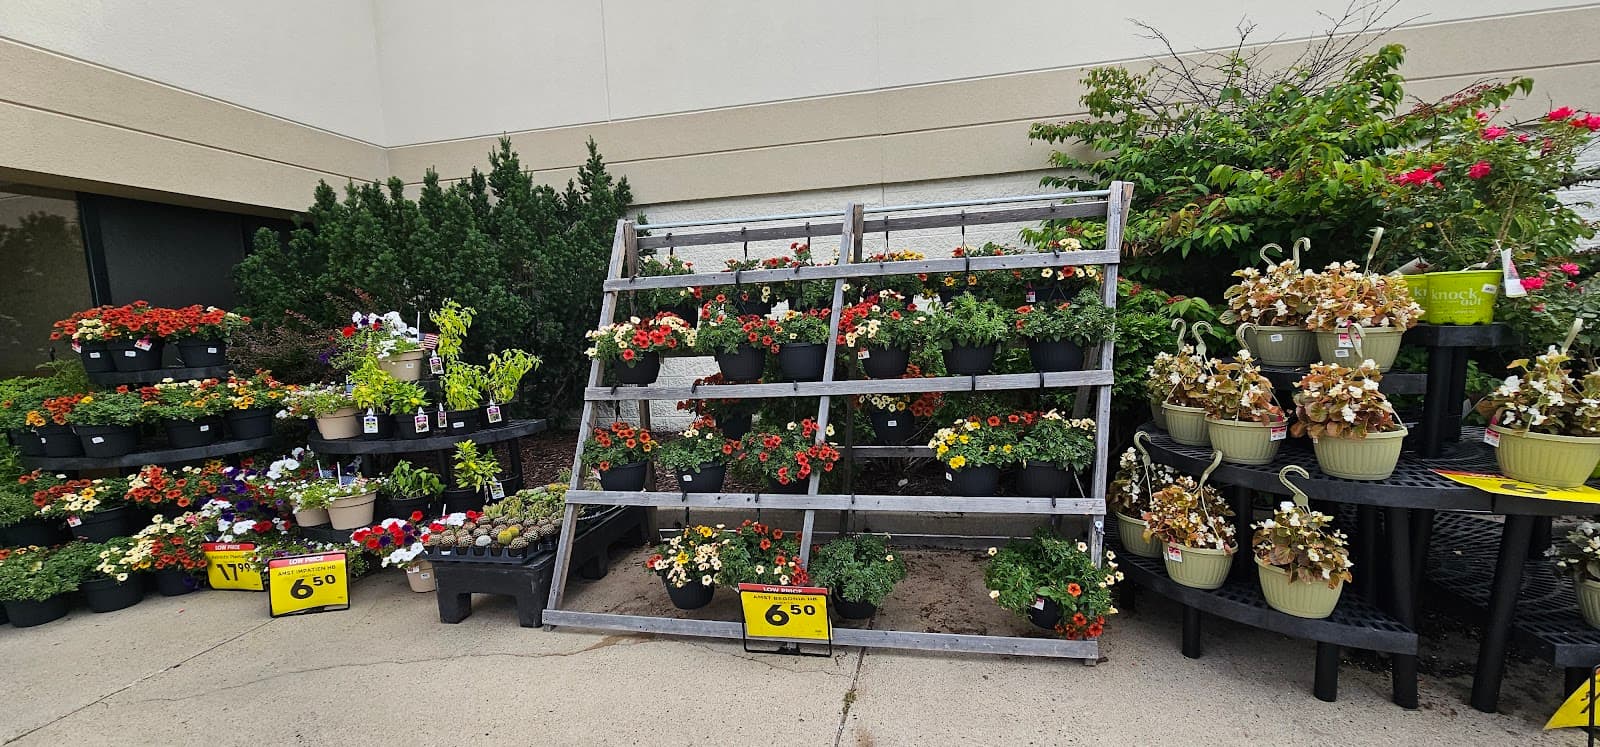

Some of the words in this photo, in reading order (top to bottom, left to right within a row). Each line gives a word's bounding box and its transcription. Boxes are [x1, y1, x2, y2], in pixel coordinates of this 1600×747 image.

[1431, 287, 1478, 300] knock
[1460, 295, 1481, 306] out
[296, 566, 326, 574] IMPATIEN
